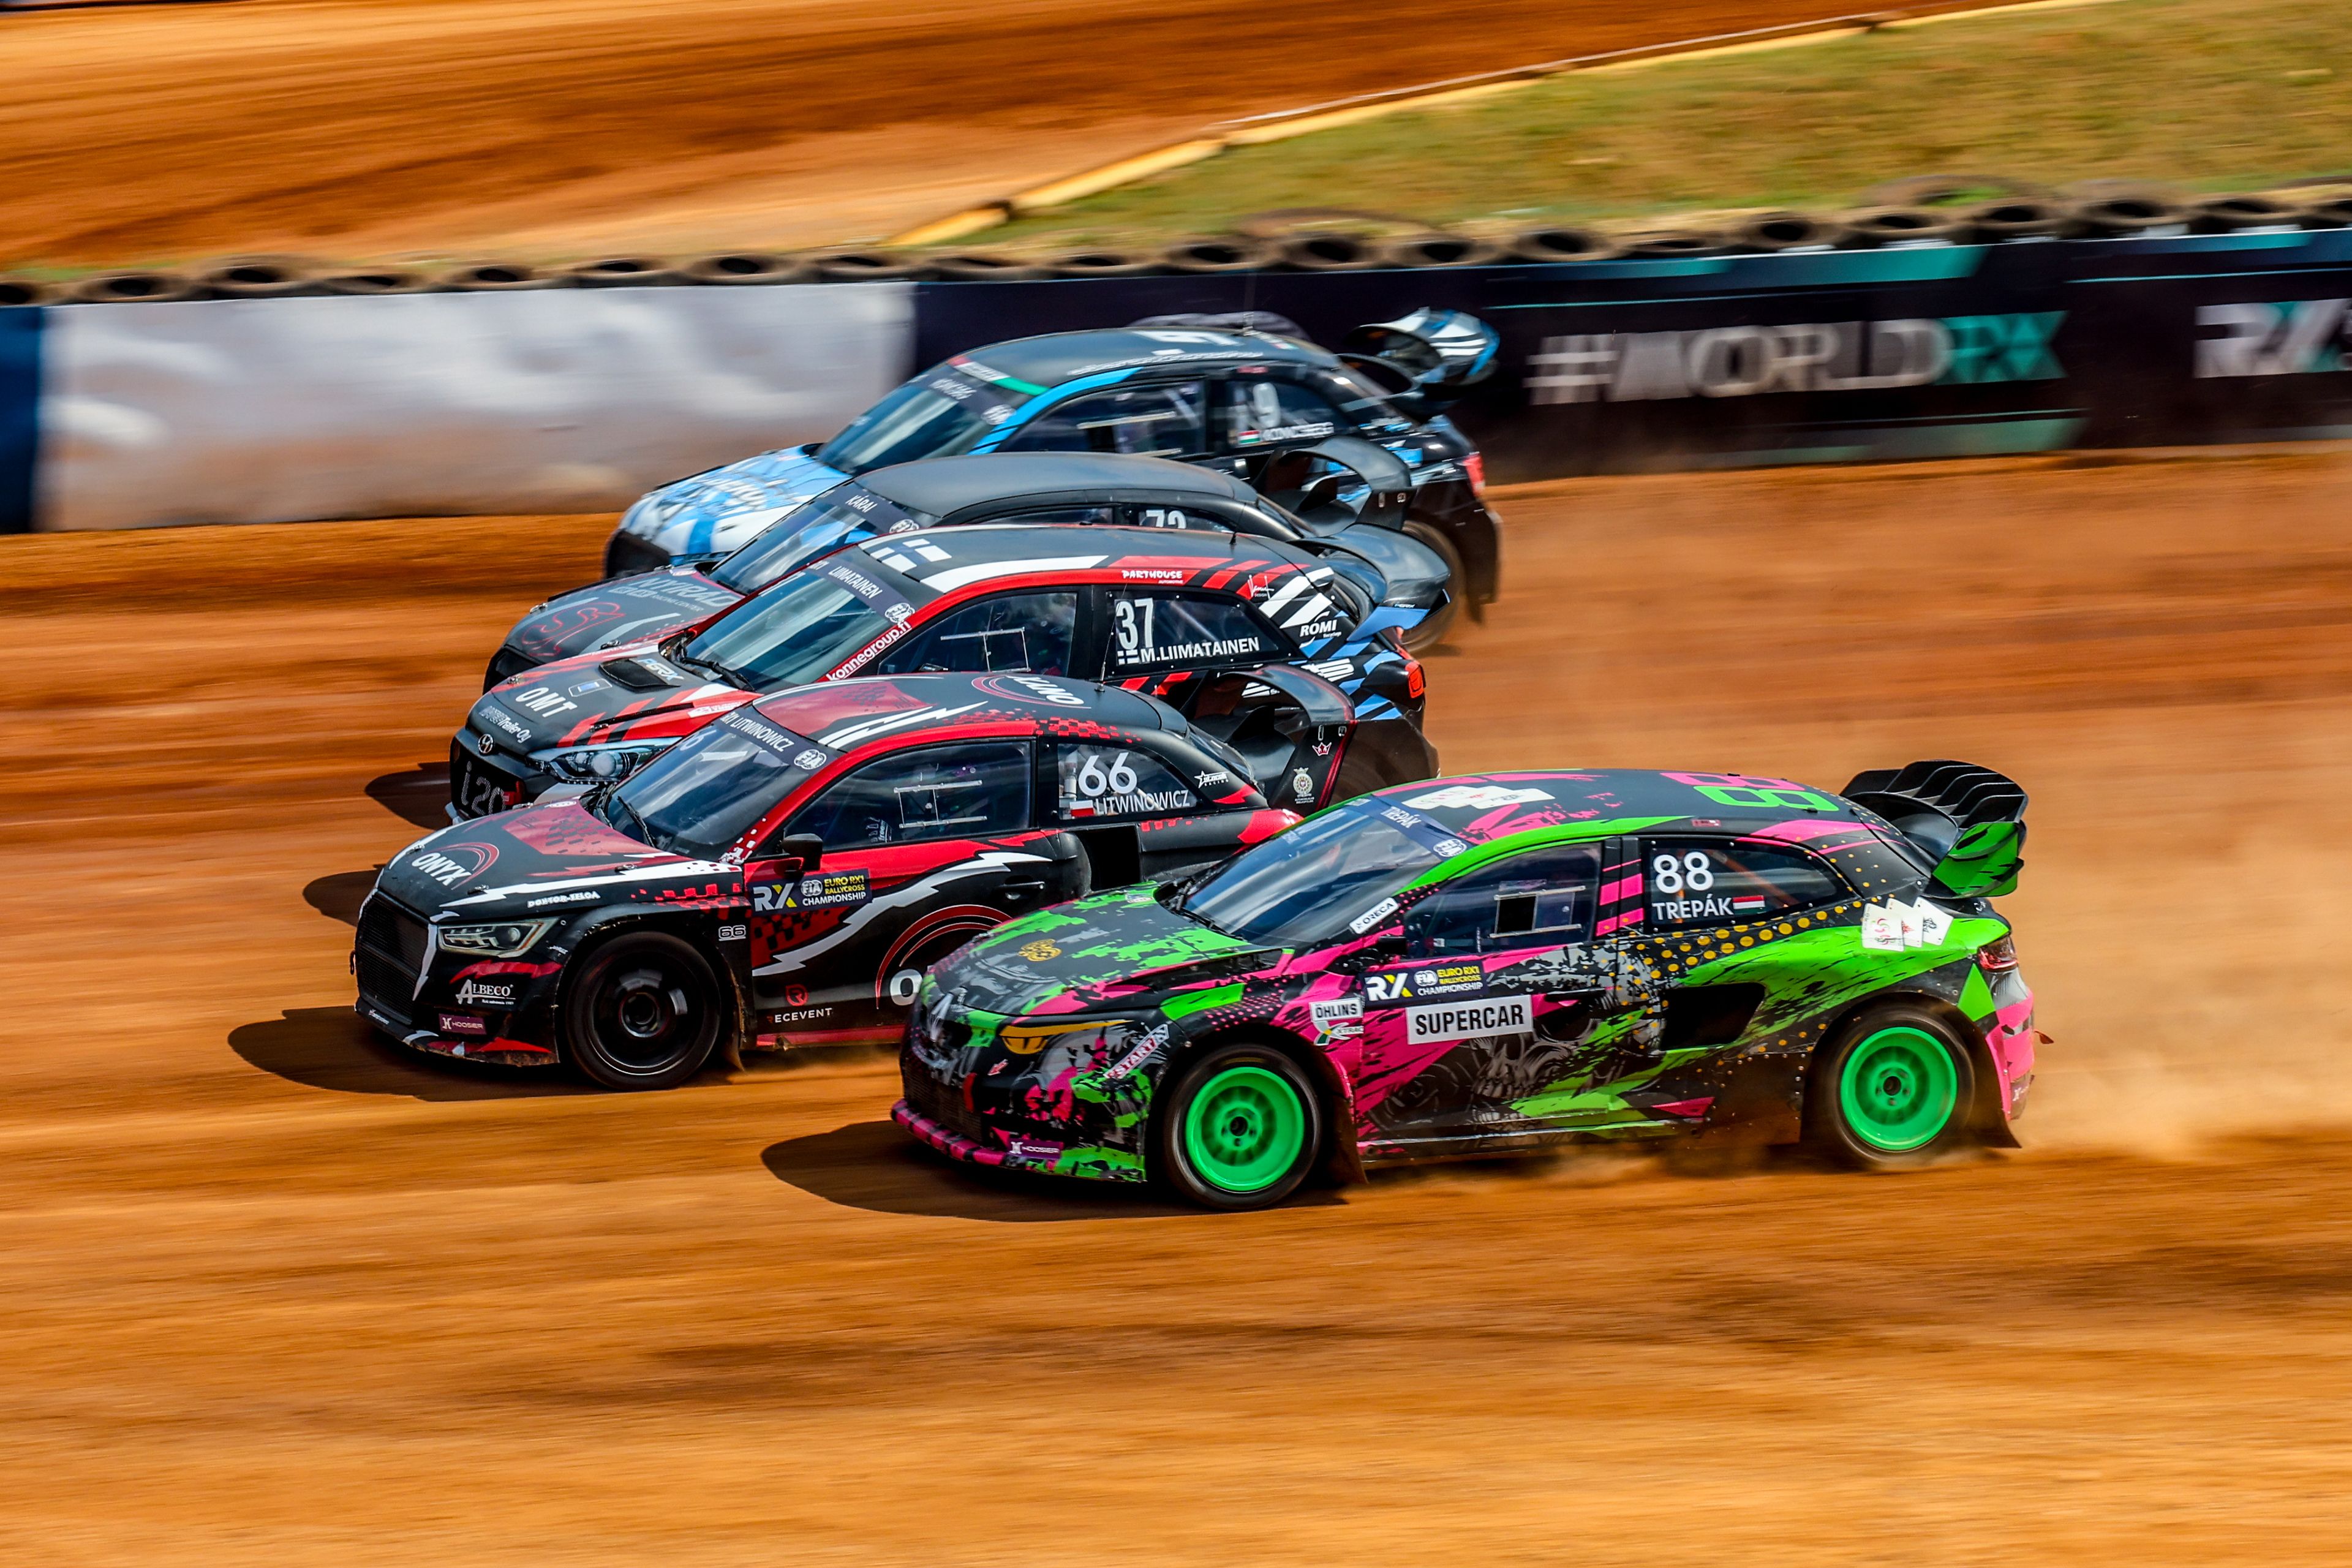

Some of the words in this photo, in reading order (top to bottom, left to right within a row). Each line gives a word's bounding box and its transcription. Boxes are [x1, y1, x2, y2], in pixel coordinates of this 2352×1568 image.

[845, 495, 878, 513] KÁRAI
[828, 565, 883, 599] LIIMATAINEN
[1121, 570, 1183, 579] PARTHOUSE
[1115, 598, 1154, 650] 37
[1299, 619, 1338, 637] ROMI
[826, 620, 912, 681] konnegroup.fi
[1140, 636, 1261, 663] M.LIIMATAINEN
[515, 687, 578, 718] OMT
[730, 717, 794, 752] LITWINOWICZ
[1078, 752, 1137, 796] 66
[1096, 790, 1190, 815] LITWINOWICZ
[1380, 806, 1422, 828] TREPÁK
[412, 852, 472, 886] ONYX
[824, 877, 846, 888] EURO
[849, 875, 865, 885] RX1
[1654, 851, 1714, 894] 88
[753, 883, 797, 912] RX
[802, 892, 867, 907] CHAMPIONSHIP
[825, 884, 865, 895] RALLYCROSS
[1363, 902, 1394, 925] ORECA
[1652, 894, 1734, 921] TREPÁK
[718, 925, 746, 940] 66
[1437, 968, 1462, 978] EURO
[456, 979, 511, 1005] ALBECO
[1365, 973, 1412, 1001] RX
[1417, 981, 1483, 996] CHAMPIONSHIP
[1316, 1004, 1357, 1018] ÖHLINS
[1415, 1005, 1524, 1036] SUPERCAR
